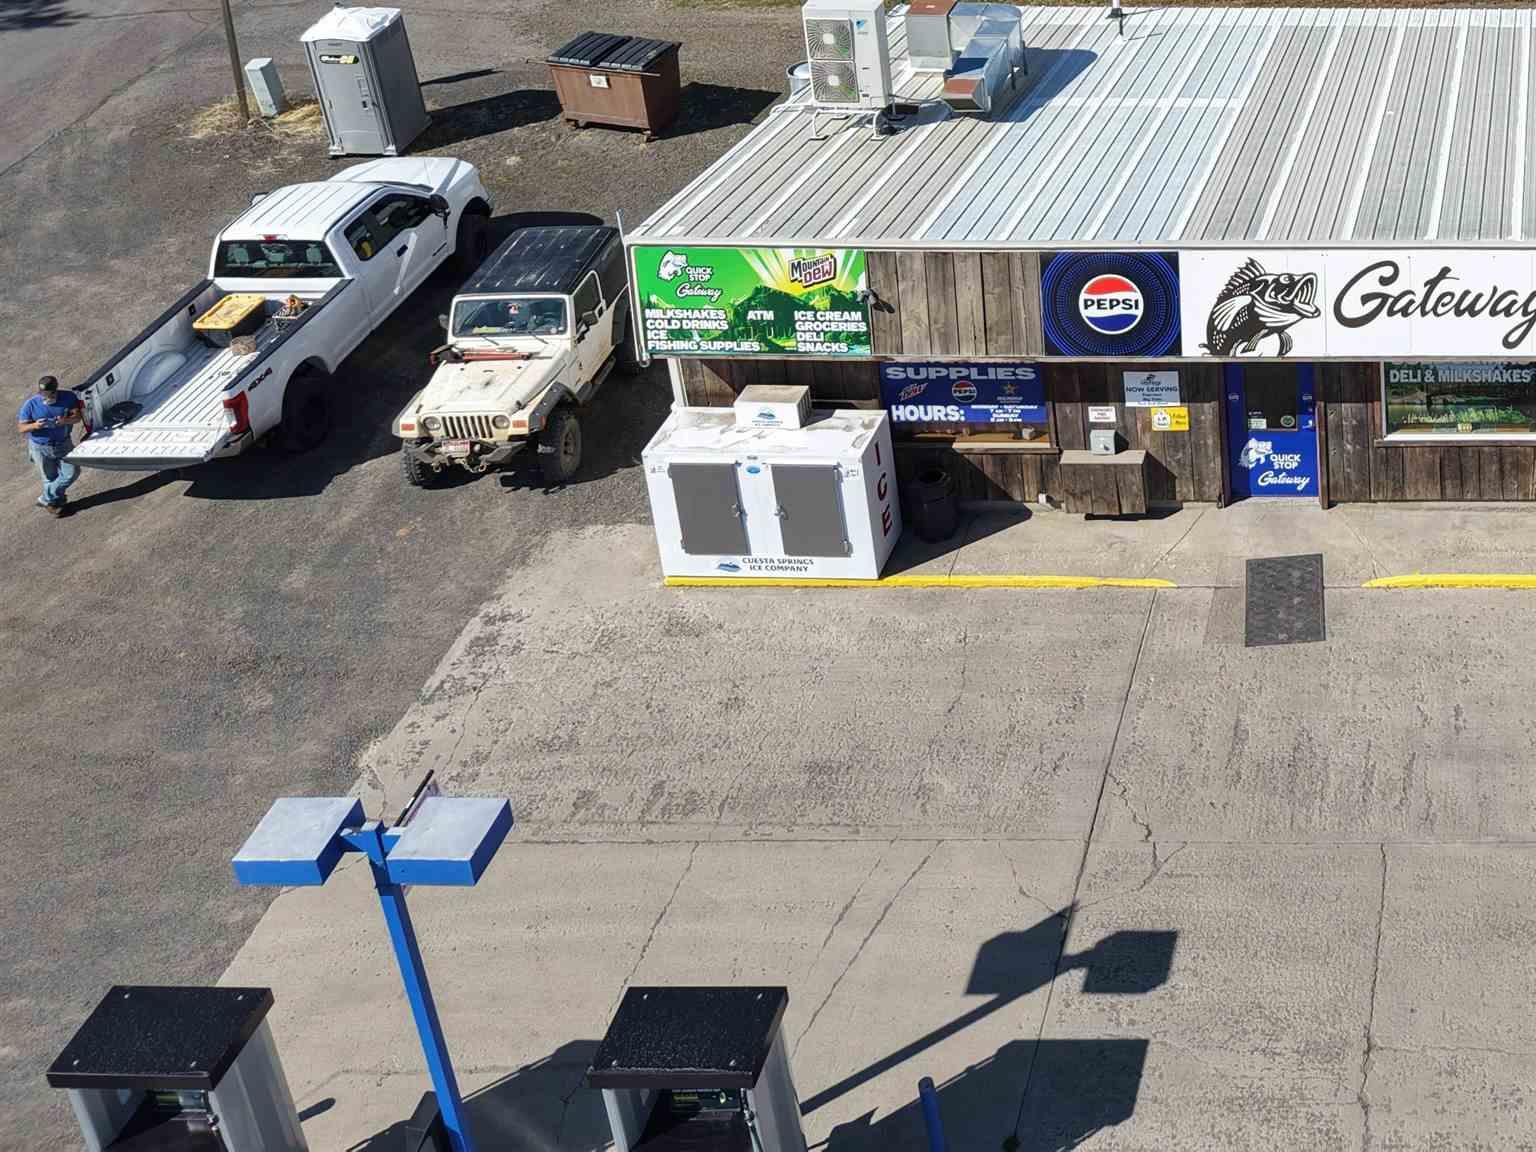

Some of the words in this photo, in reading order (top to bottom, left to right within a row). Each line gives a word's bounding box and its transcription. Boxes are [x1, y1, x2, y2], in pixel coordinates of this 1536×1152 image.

[686, 266, 712, 275] QUICK
[688, 274, 711, 282] STOP
[677, 283, 722, 302] Gateway
[1083, 297, 1140, 311] PEPSI
[645, 309, 726, 320] MILKSHAKES
[747, 310, 774, 320] ATM
[794, 311, 814, 320] ICE
[817, 311, 862, 321] CREAM
[646, 320, 681, 329] COLD
[682, 320, 728, 330] DRINKS
[795, 322, 867, 331] GROCERIES
[647, 330, 667, 339] ICE
[796, 332, 824, 341] DELI
[647, 341, 698, 351] FISHING
[700, 341, 760, 351] SUPPLIES
[797, 342, 848, 352] SNACKS
[885, 367, 1036, 380] SUPPLIES
[1390, 370, 1421, 382] DELI
[1424, 370, 1435, 382] &
[1438, 369, 1531, 382] MILKSHAKES
[891, 404, 966, 422] HOURS:
[1270, 454, 1301, 462] QUICK
[1258, 471, 1310, 490] Gateway
[874, 441, 893, 537] ICE
[742, 557, 775, 565] CUESTA
[777, 558, 814, 566] SPRINGS
